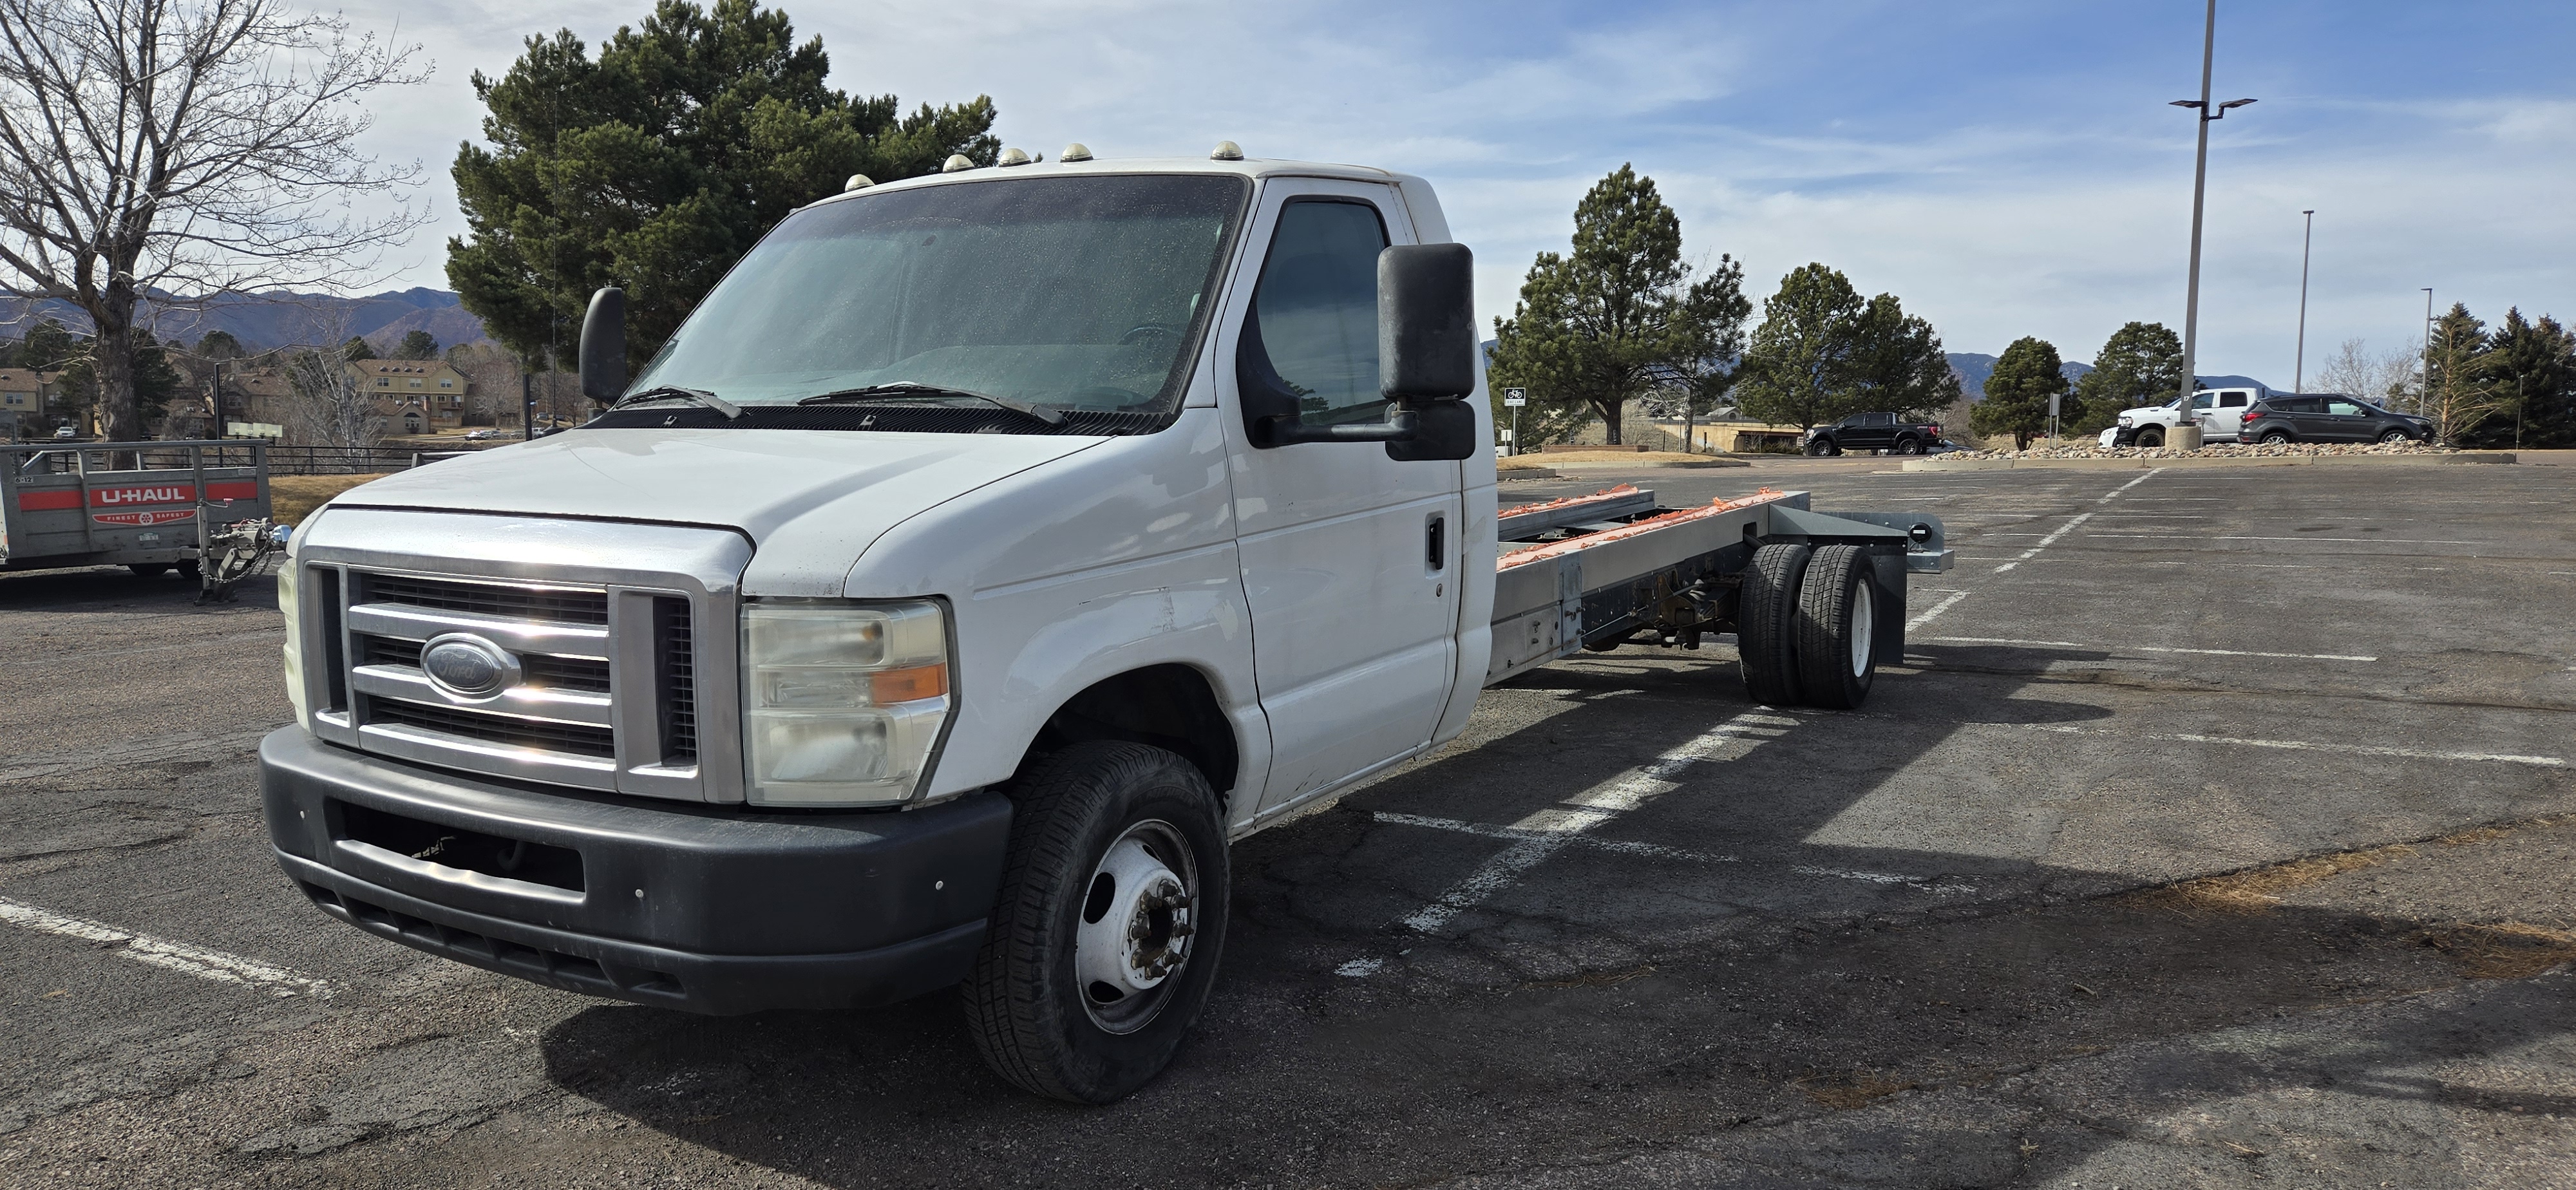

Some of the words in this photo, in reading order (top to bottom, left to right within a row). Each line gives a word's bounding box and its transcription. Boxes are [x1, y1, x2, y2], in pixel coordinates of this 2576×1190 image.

[101, 488, 185, 503] U-HAUL
[438, 652, 479, 679] Ford
[1146, 787, 1193, 807] MICHELIN
